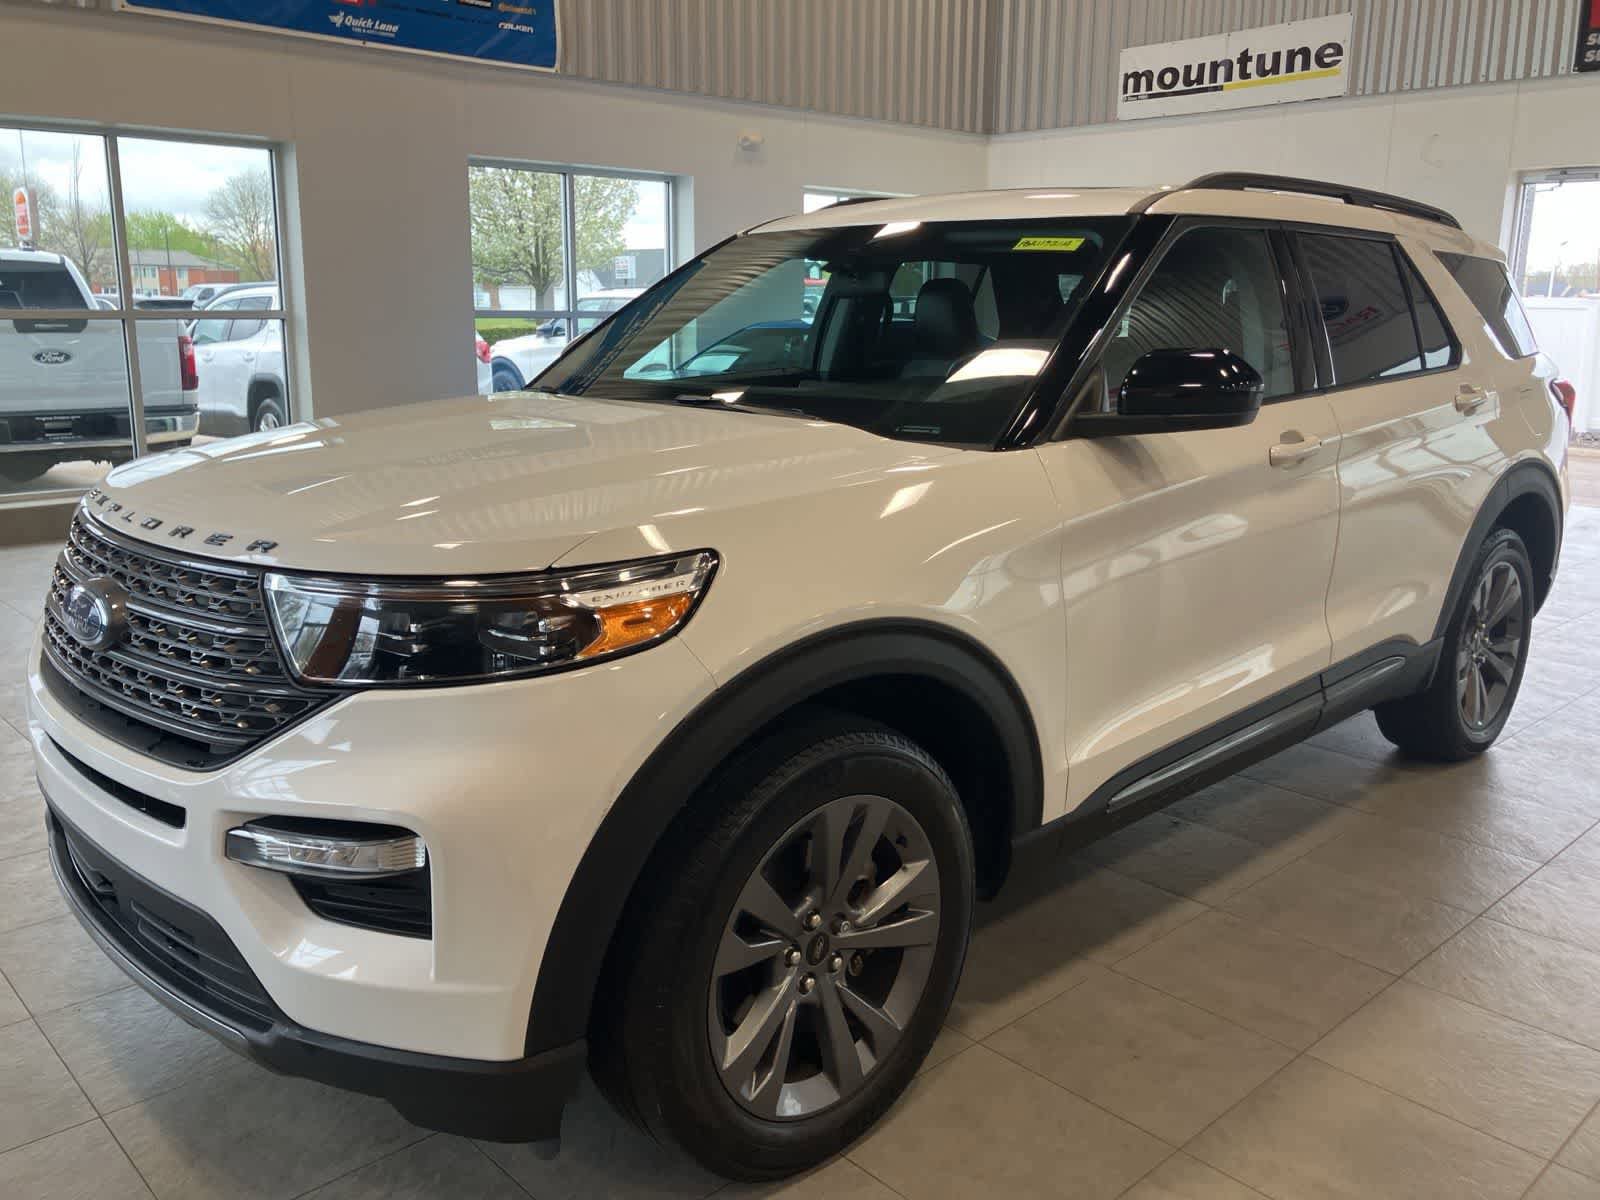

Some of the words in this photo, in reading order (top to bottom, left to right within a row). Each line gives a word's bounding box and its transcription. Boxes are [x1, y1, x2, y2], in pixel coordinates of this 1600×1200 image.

[345, 15, 374, 29] Quick
[374, 20, 399, 33] Lane
[1122, 40, 1344, 96] mountune
[88, 488, 279, 554] EXPLORER
